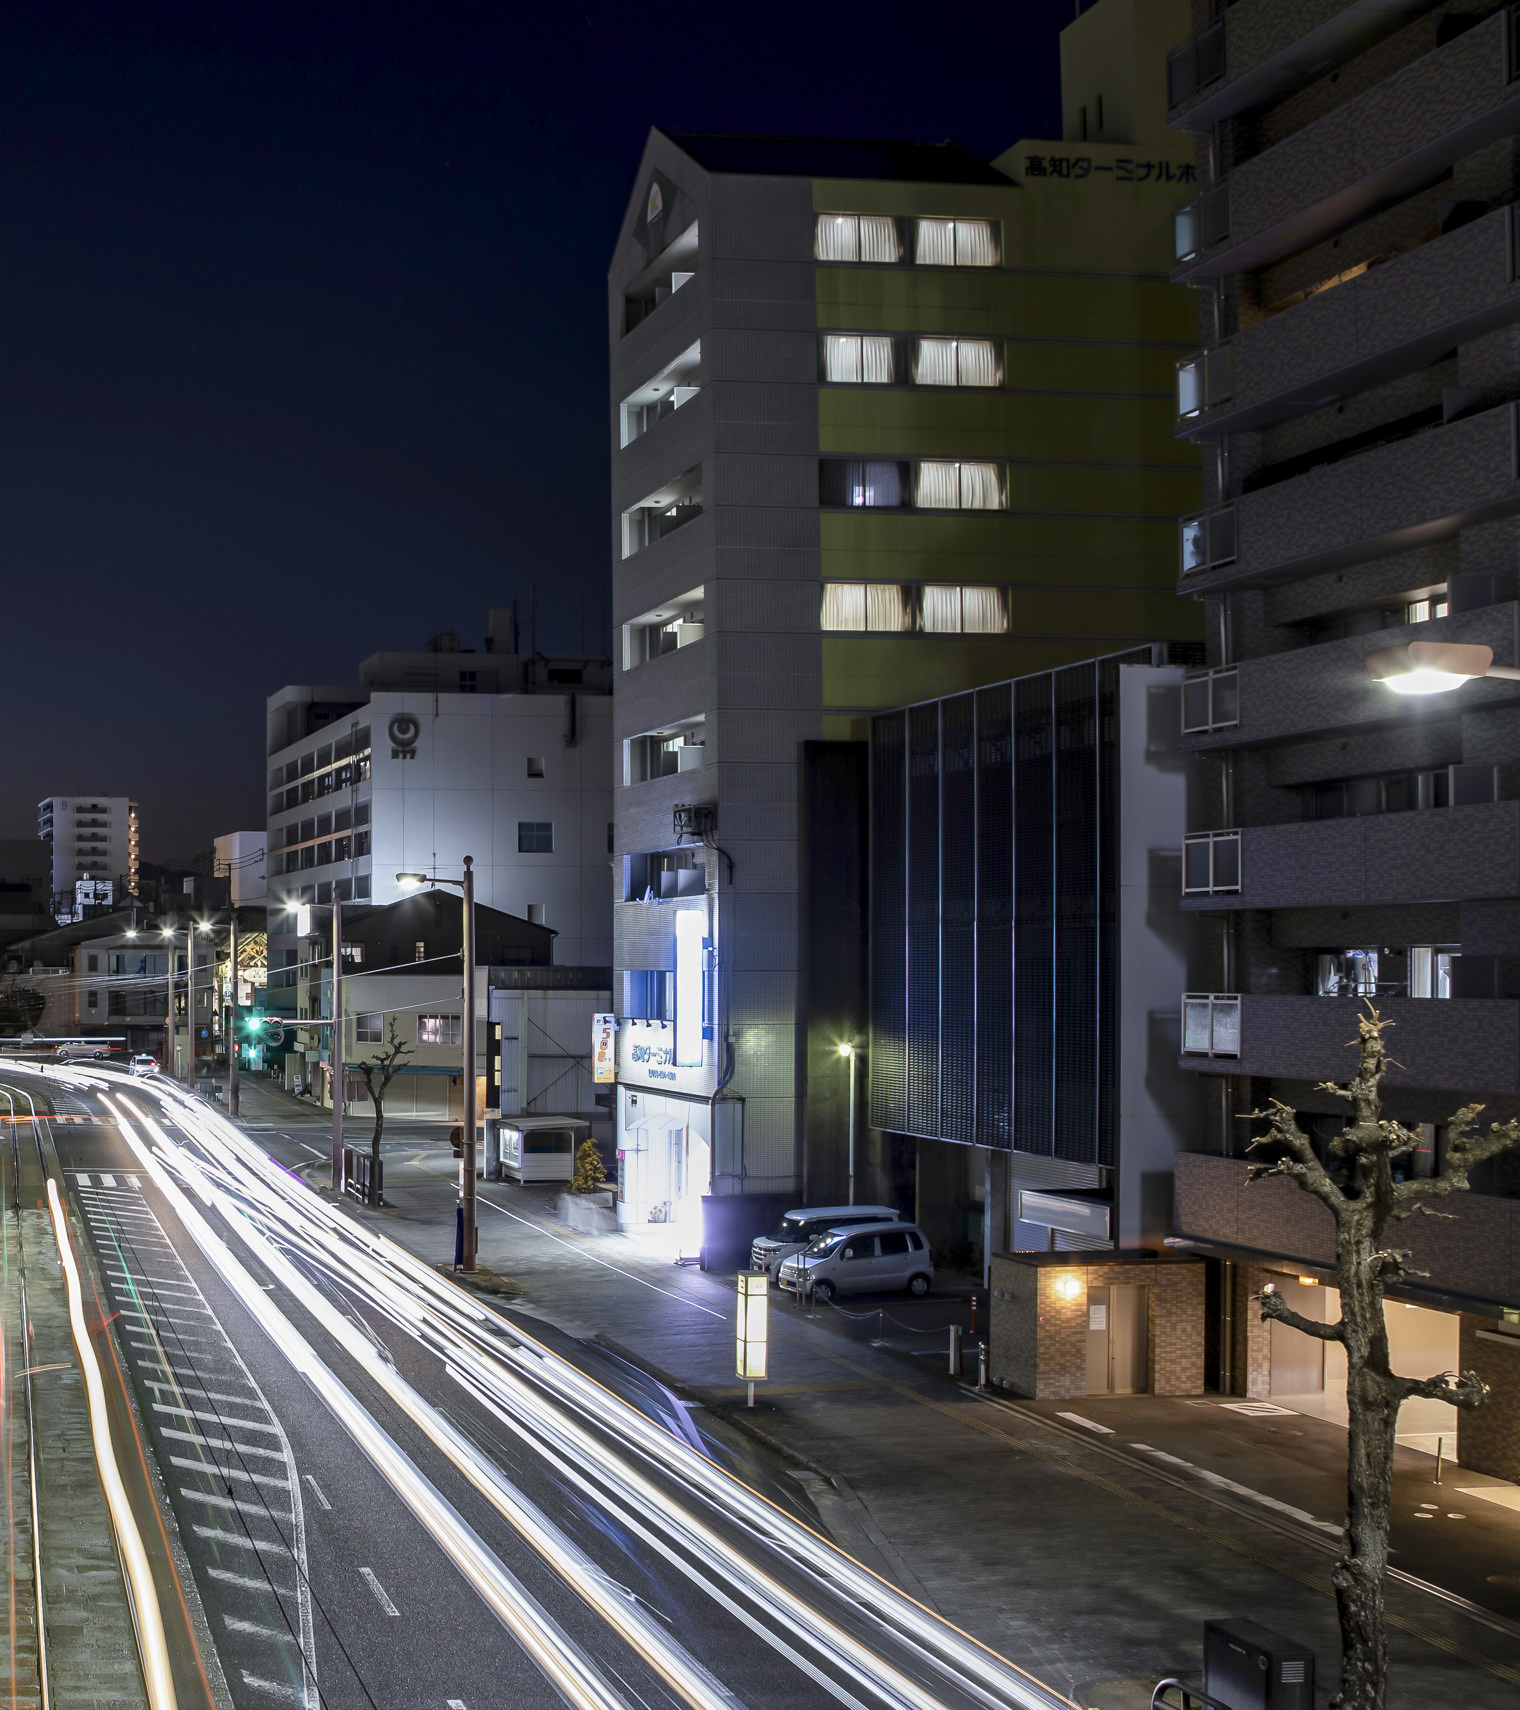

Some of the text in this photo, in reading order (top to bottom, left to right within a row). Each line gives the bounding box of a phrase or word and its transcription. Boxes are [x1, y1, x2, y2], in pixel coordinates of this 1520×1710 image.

[1024, 155, 1198, 183] 高知ターミナルホ
